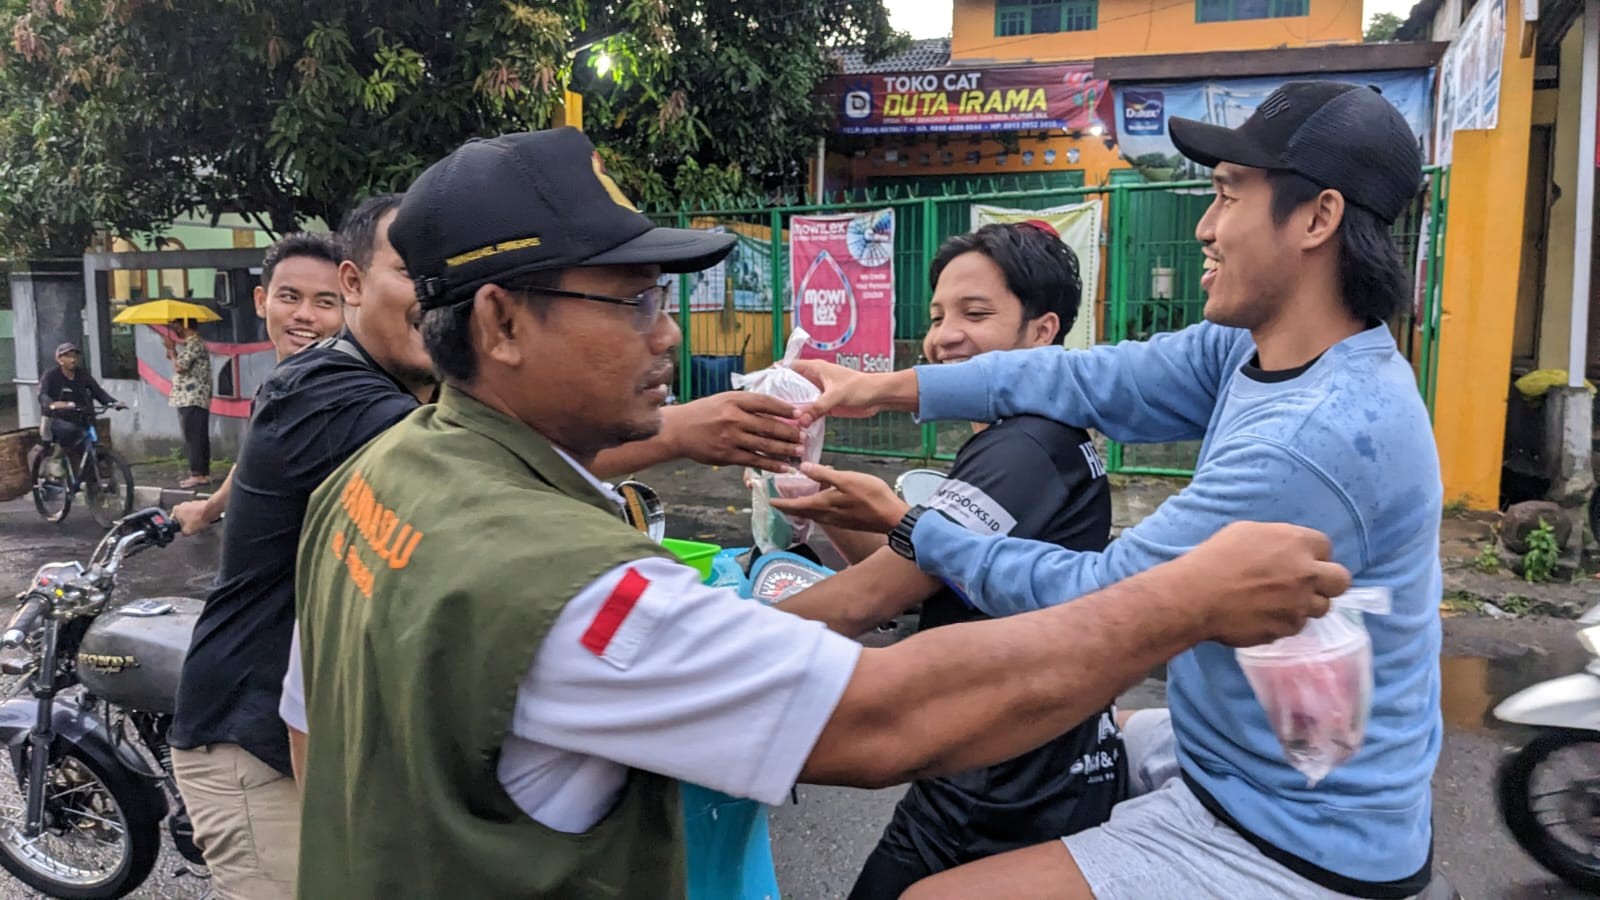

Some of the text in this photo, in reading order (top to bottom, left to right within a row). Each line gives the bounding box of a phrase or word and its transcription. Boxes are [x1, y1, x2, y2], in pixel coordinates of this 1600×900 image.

[884, 72, 981, 93] TOKO CAT
[883, 88, 1048, 117] DUTA IRAMA
